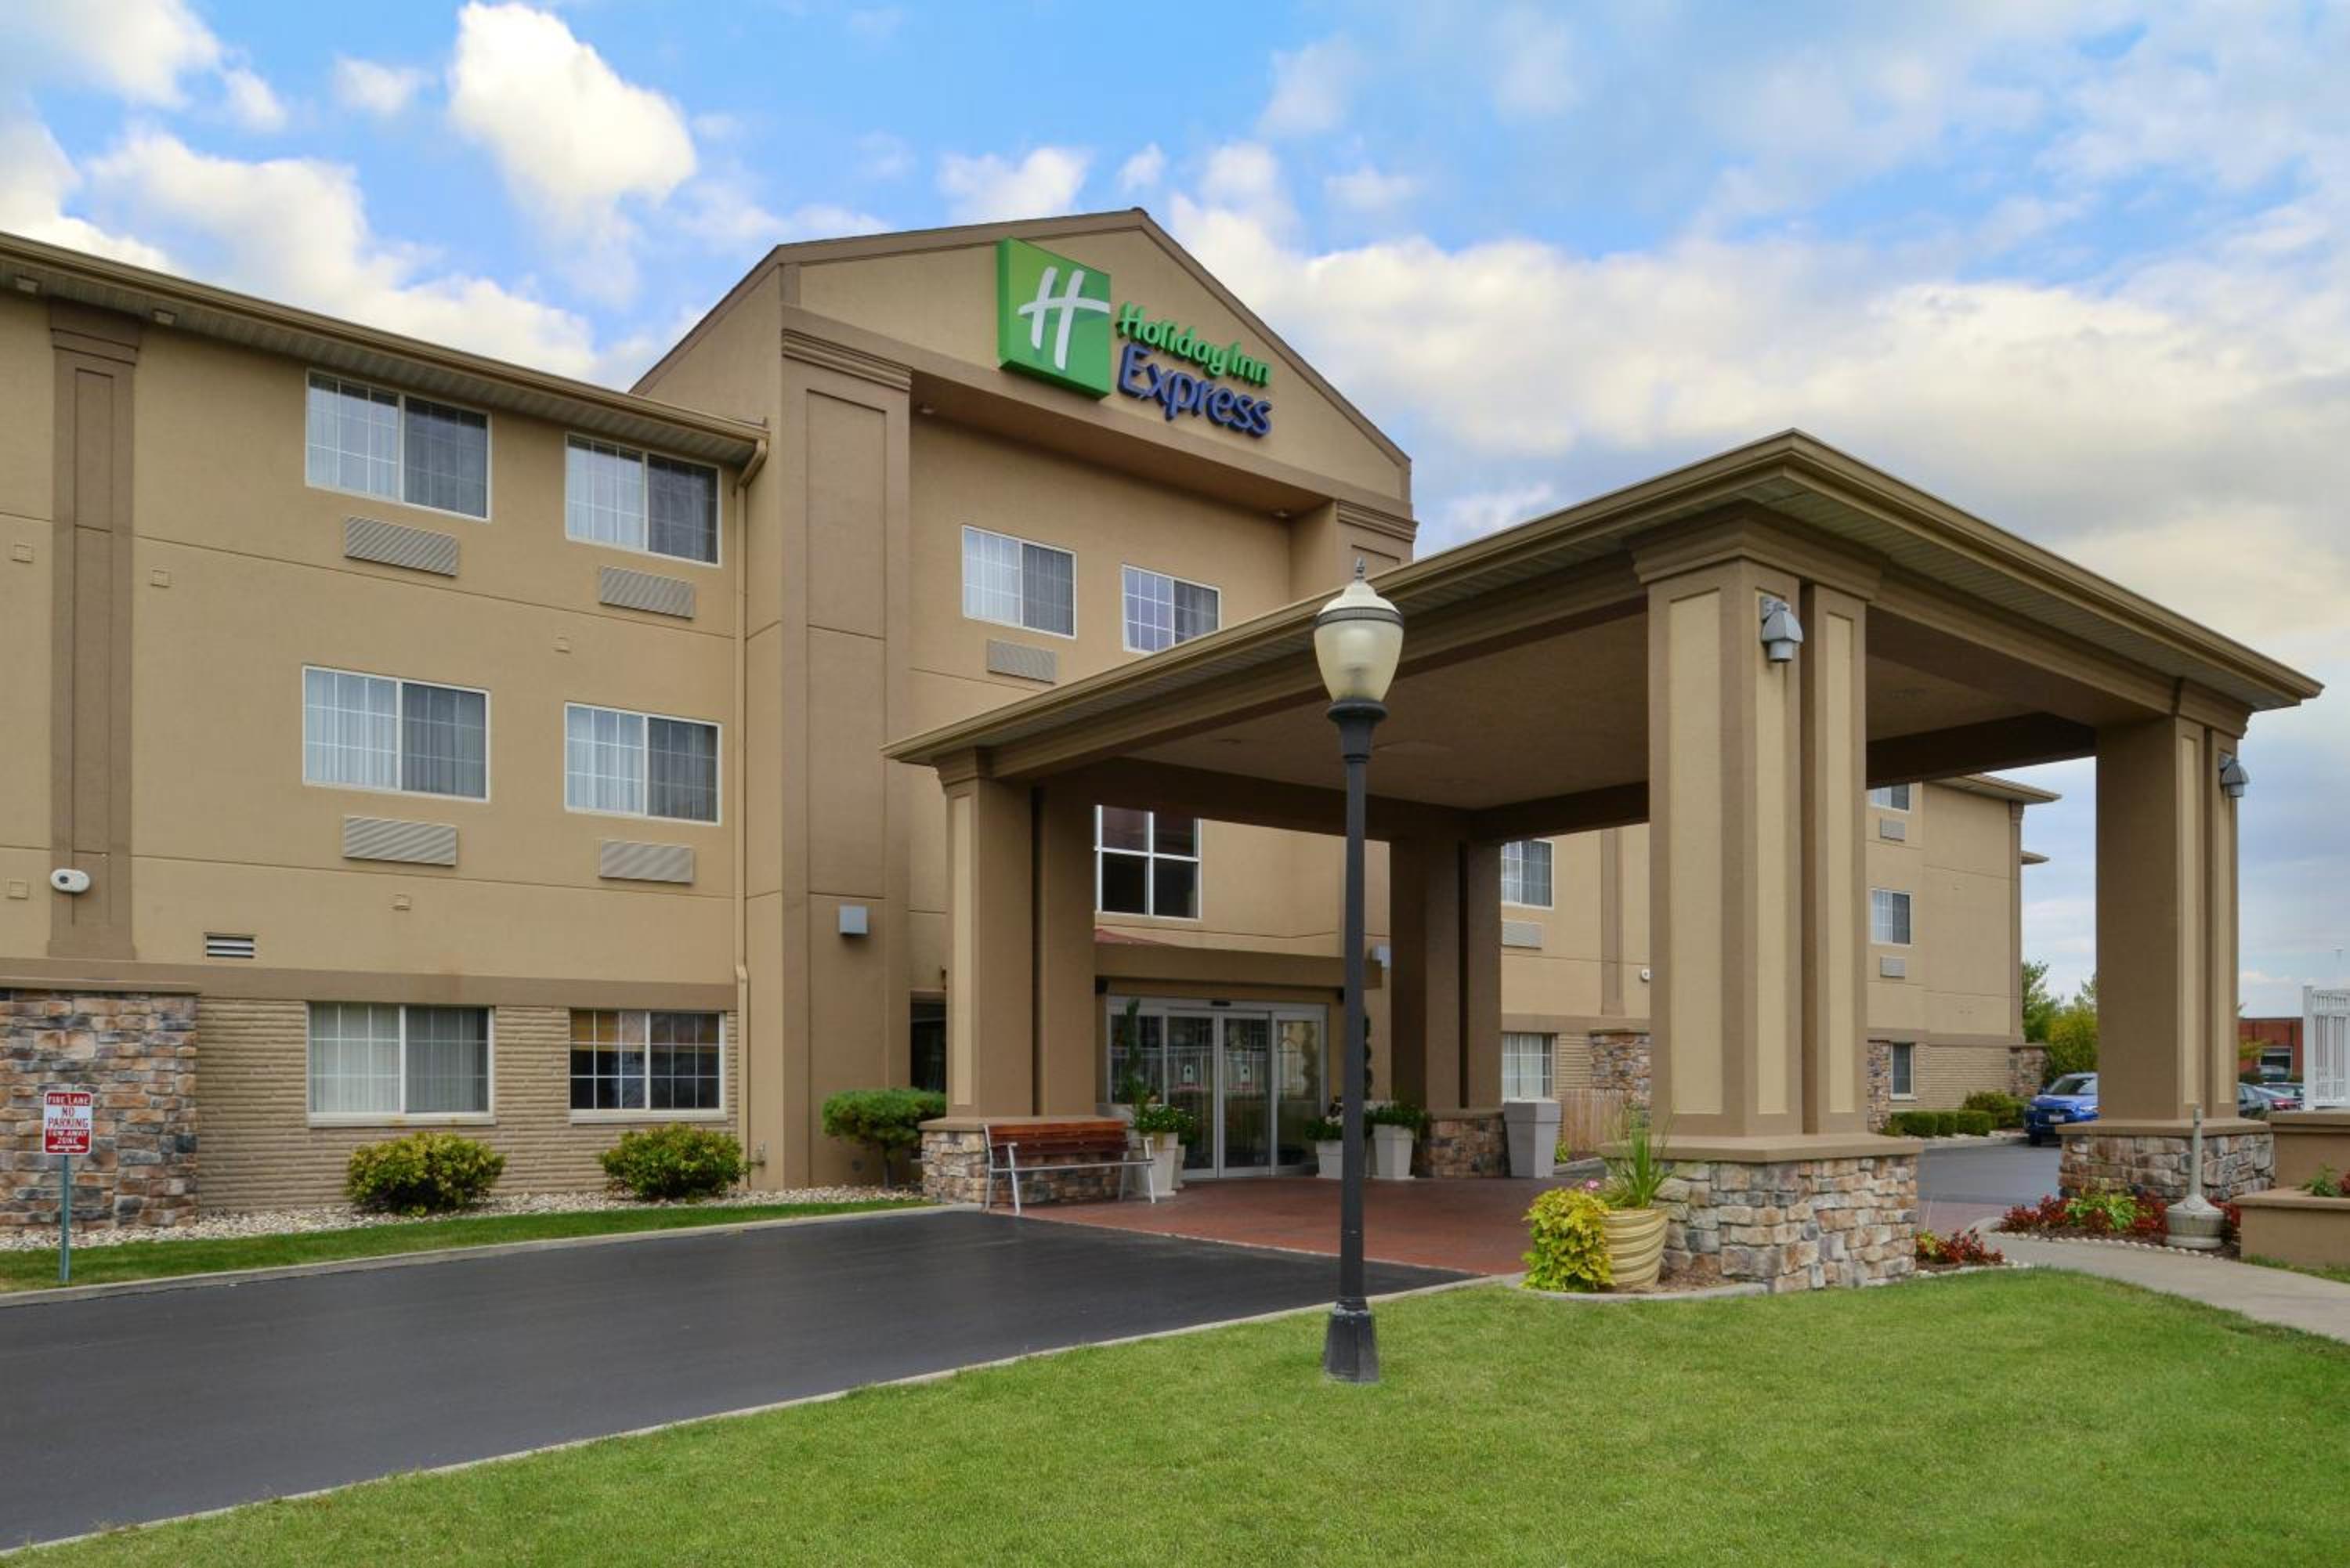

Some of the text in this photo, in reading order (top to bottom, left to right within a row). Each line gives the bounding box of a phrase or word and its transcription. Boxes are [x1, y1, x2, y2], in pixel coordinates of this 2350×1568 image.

[1116, 302, 1271, 387] Holiday Inn
[1118, 343, 1272, 437] Express
[66, 1095, 89, 1105] LANE
[62, 1107, 75, 1117] NO
[48, 1117, 89, 1129] PARKING
